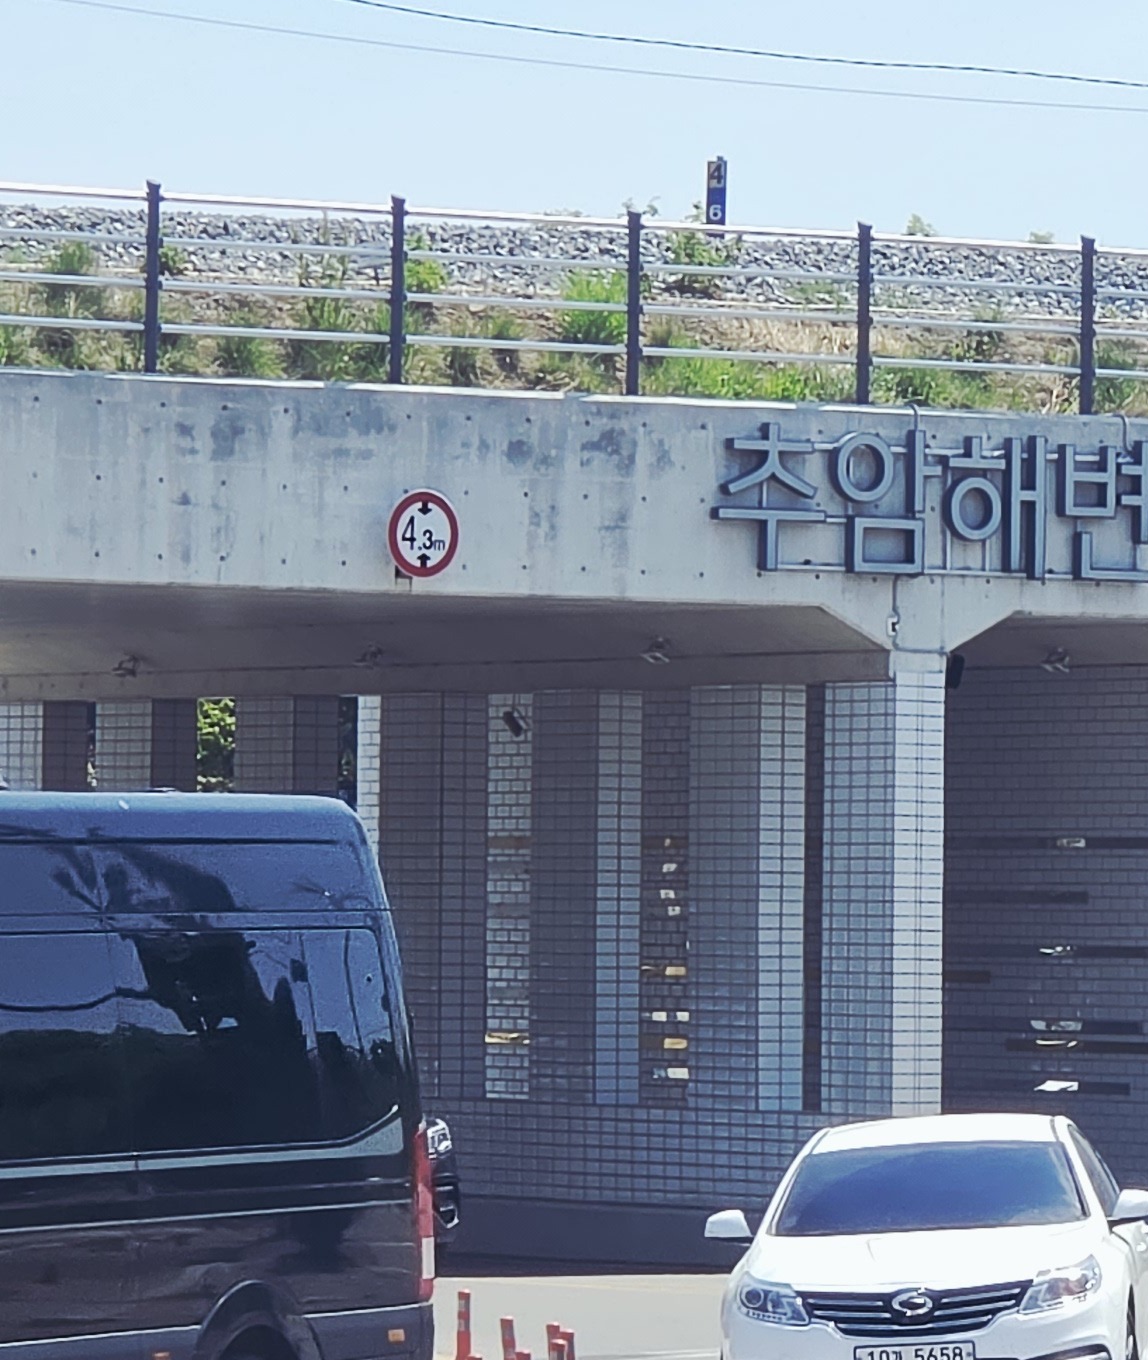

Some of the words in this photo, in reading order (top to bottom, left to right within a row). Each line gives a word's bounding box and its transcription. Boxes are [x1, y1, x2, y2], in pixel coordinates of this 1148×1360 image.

[709, 162, 724, 185] 4
[708, 204, 723, 221] 6
[401, 515, 446, 552] 4.3m
